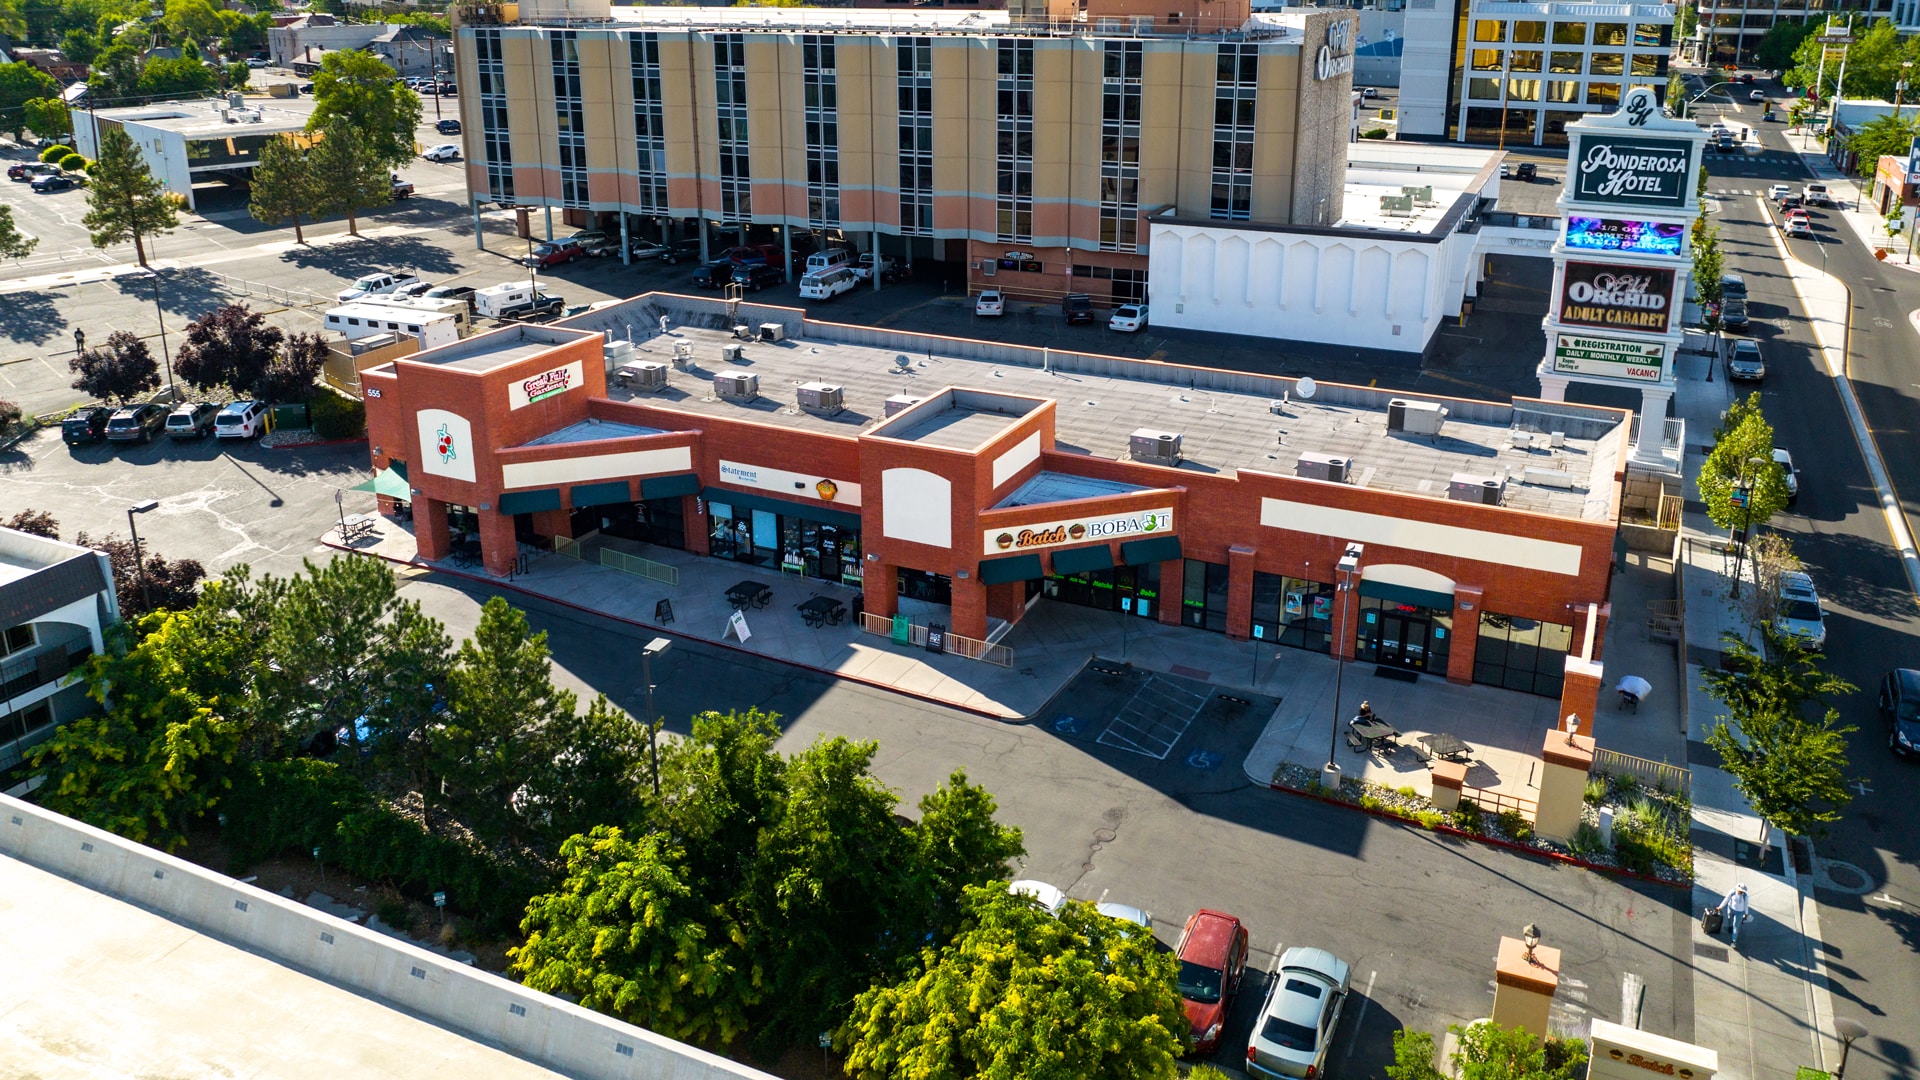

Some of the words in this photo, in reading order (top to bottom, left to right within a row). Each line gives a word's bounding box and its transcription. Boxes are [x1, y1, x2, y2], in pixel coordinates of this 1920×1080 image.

[1581, 145, 1686, 173] PONDEROSA
[1598, 169, 1662, 195] HOTEL
[1568, 281, 1666, 310] ORCHID
[1563, 305, 1606, 323] ADULT
[1606, 309, 1666, 328] CABARET
[1566, 349, 1585, 358] DAILY
[1589, 351, 1620, 361] MONTHLY
[1626, 356, 1652, 364] WEEKLY
[1581, 339, 1642, 353] REGISTRATION
[1627, 367, 1658, 378] VACANCY
[367, 388, 381, 399] 555
[721, 465, 757, 478] Statement
[1016, 525, 1067, 548] Batch
[1088, 519, 1140, 538] BOBA
[1626, 1053, 1675, 1076] Batch
